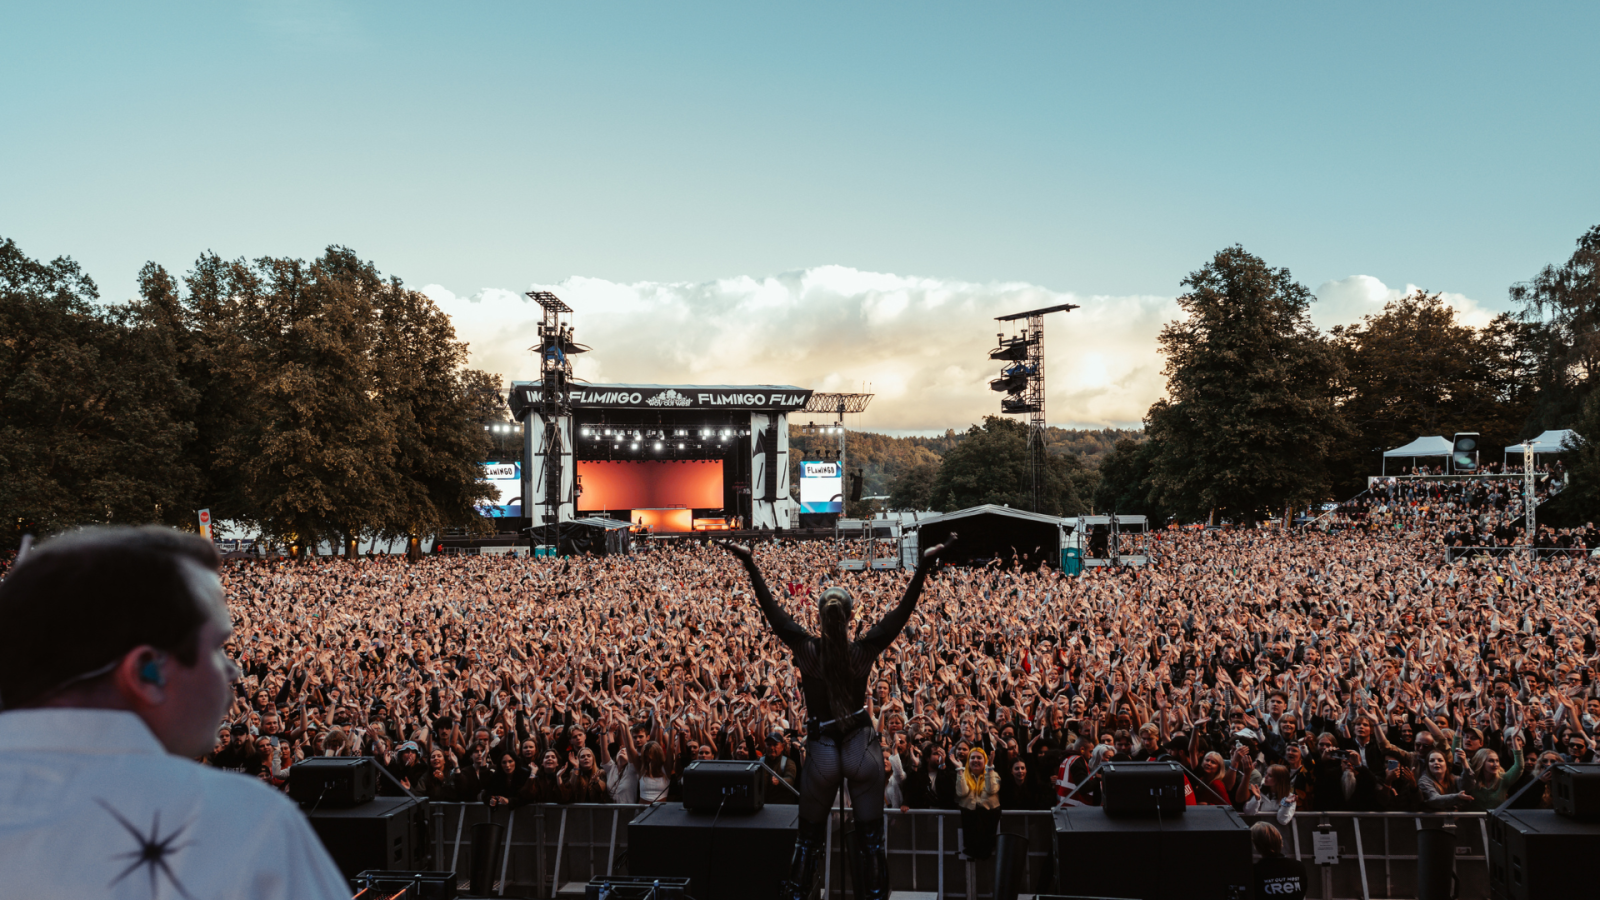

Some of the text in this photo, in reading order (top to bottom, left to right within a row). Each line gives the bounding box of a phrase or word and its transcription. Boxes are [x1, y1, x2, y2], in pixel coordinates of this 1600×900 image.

[567, 391, 642, 404] FLAMINGO
[698, 393, 806, 405] FLAMINGO FLAM
[485, 467, 512, 475] LAMINGO
[807, 466, 834, 474] FLAMINGO
